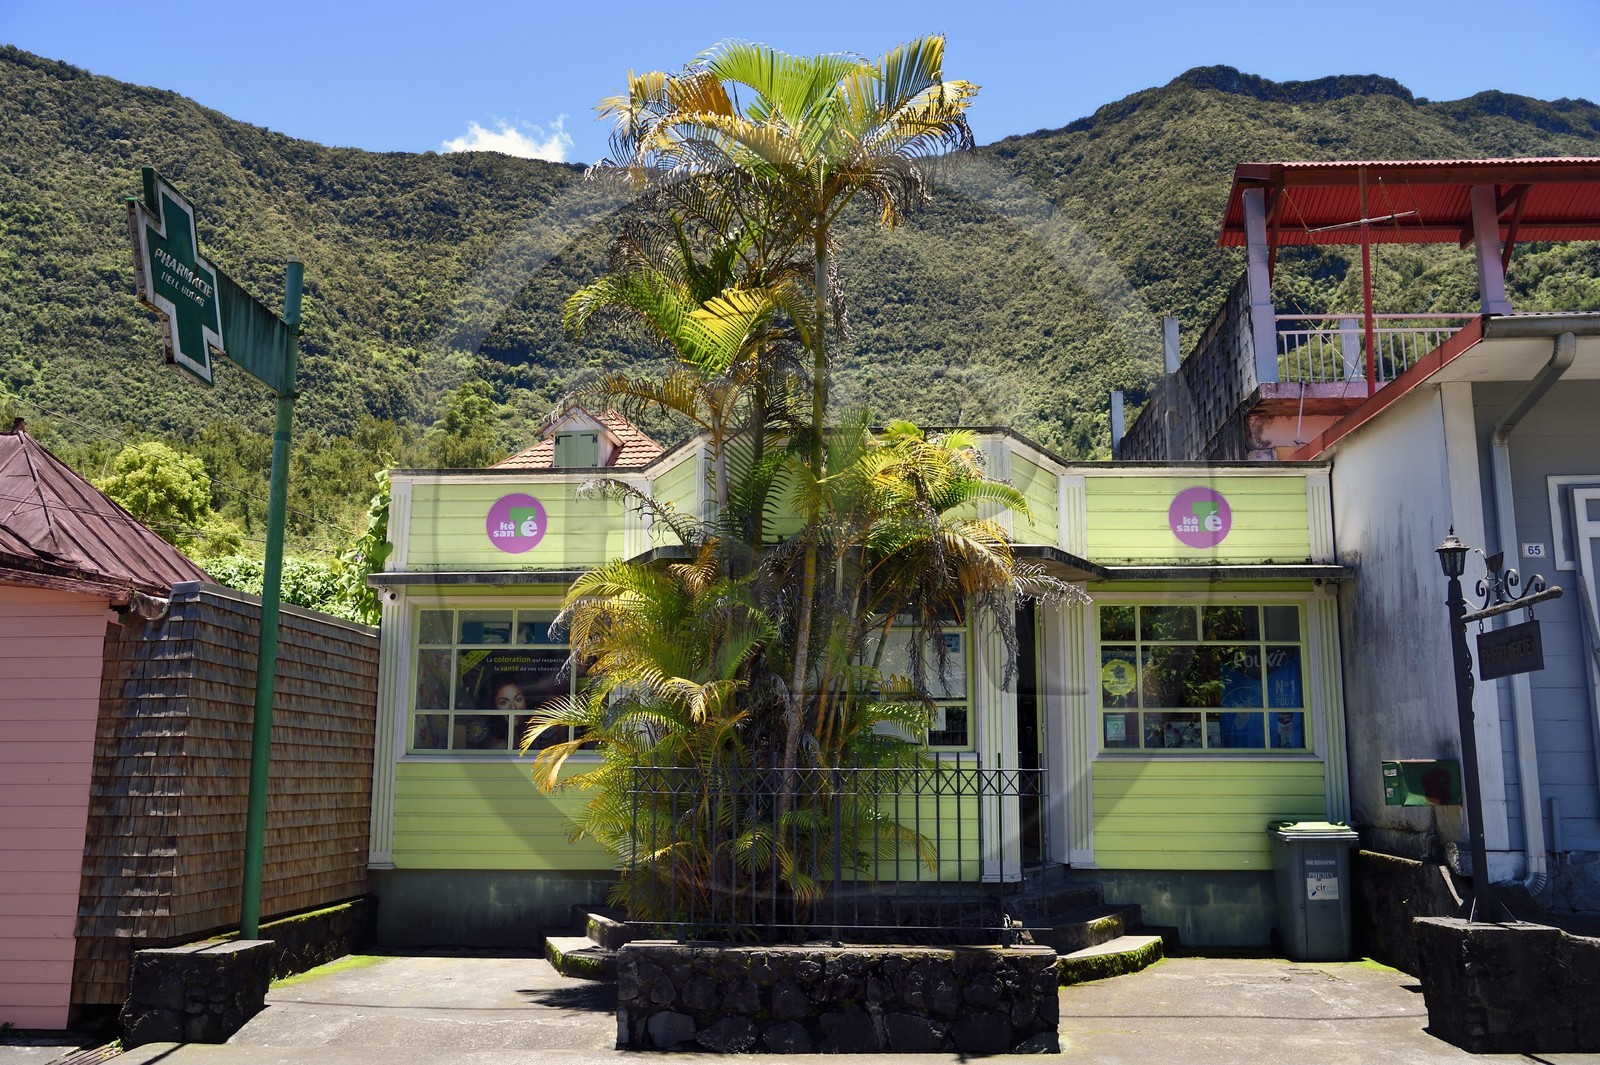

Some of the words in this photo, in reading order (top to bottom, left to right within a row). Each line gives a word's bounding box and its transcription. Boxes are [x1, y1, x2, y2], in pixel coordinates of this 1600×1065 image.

[154, 248, 213, 298] PHARMACIE
[1528, 545, 1541, 555] 65
[493, 655, 531, 663] coloration
[500, 664, 520, 672] santé
[1275, 697, 1295, 706] POUX
